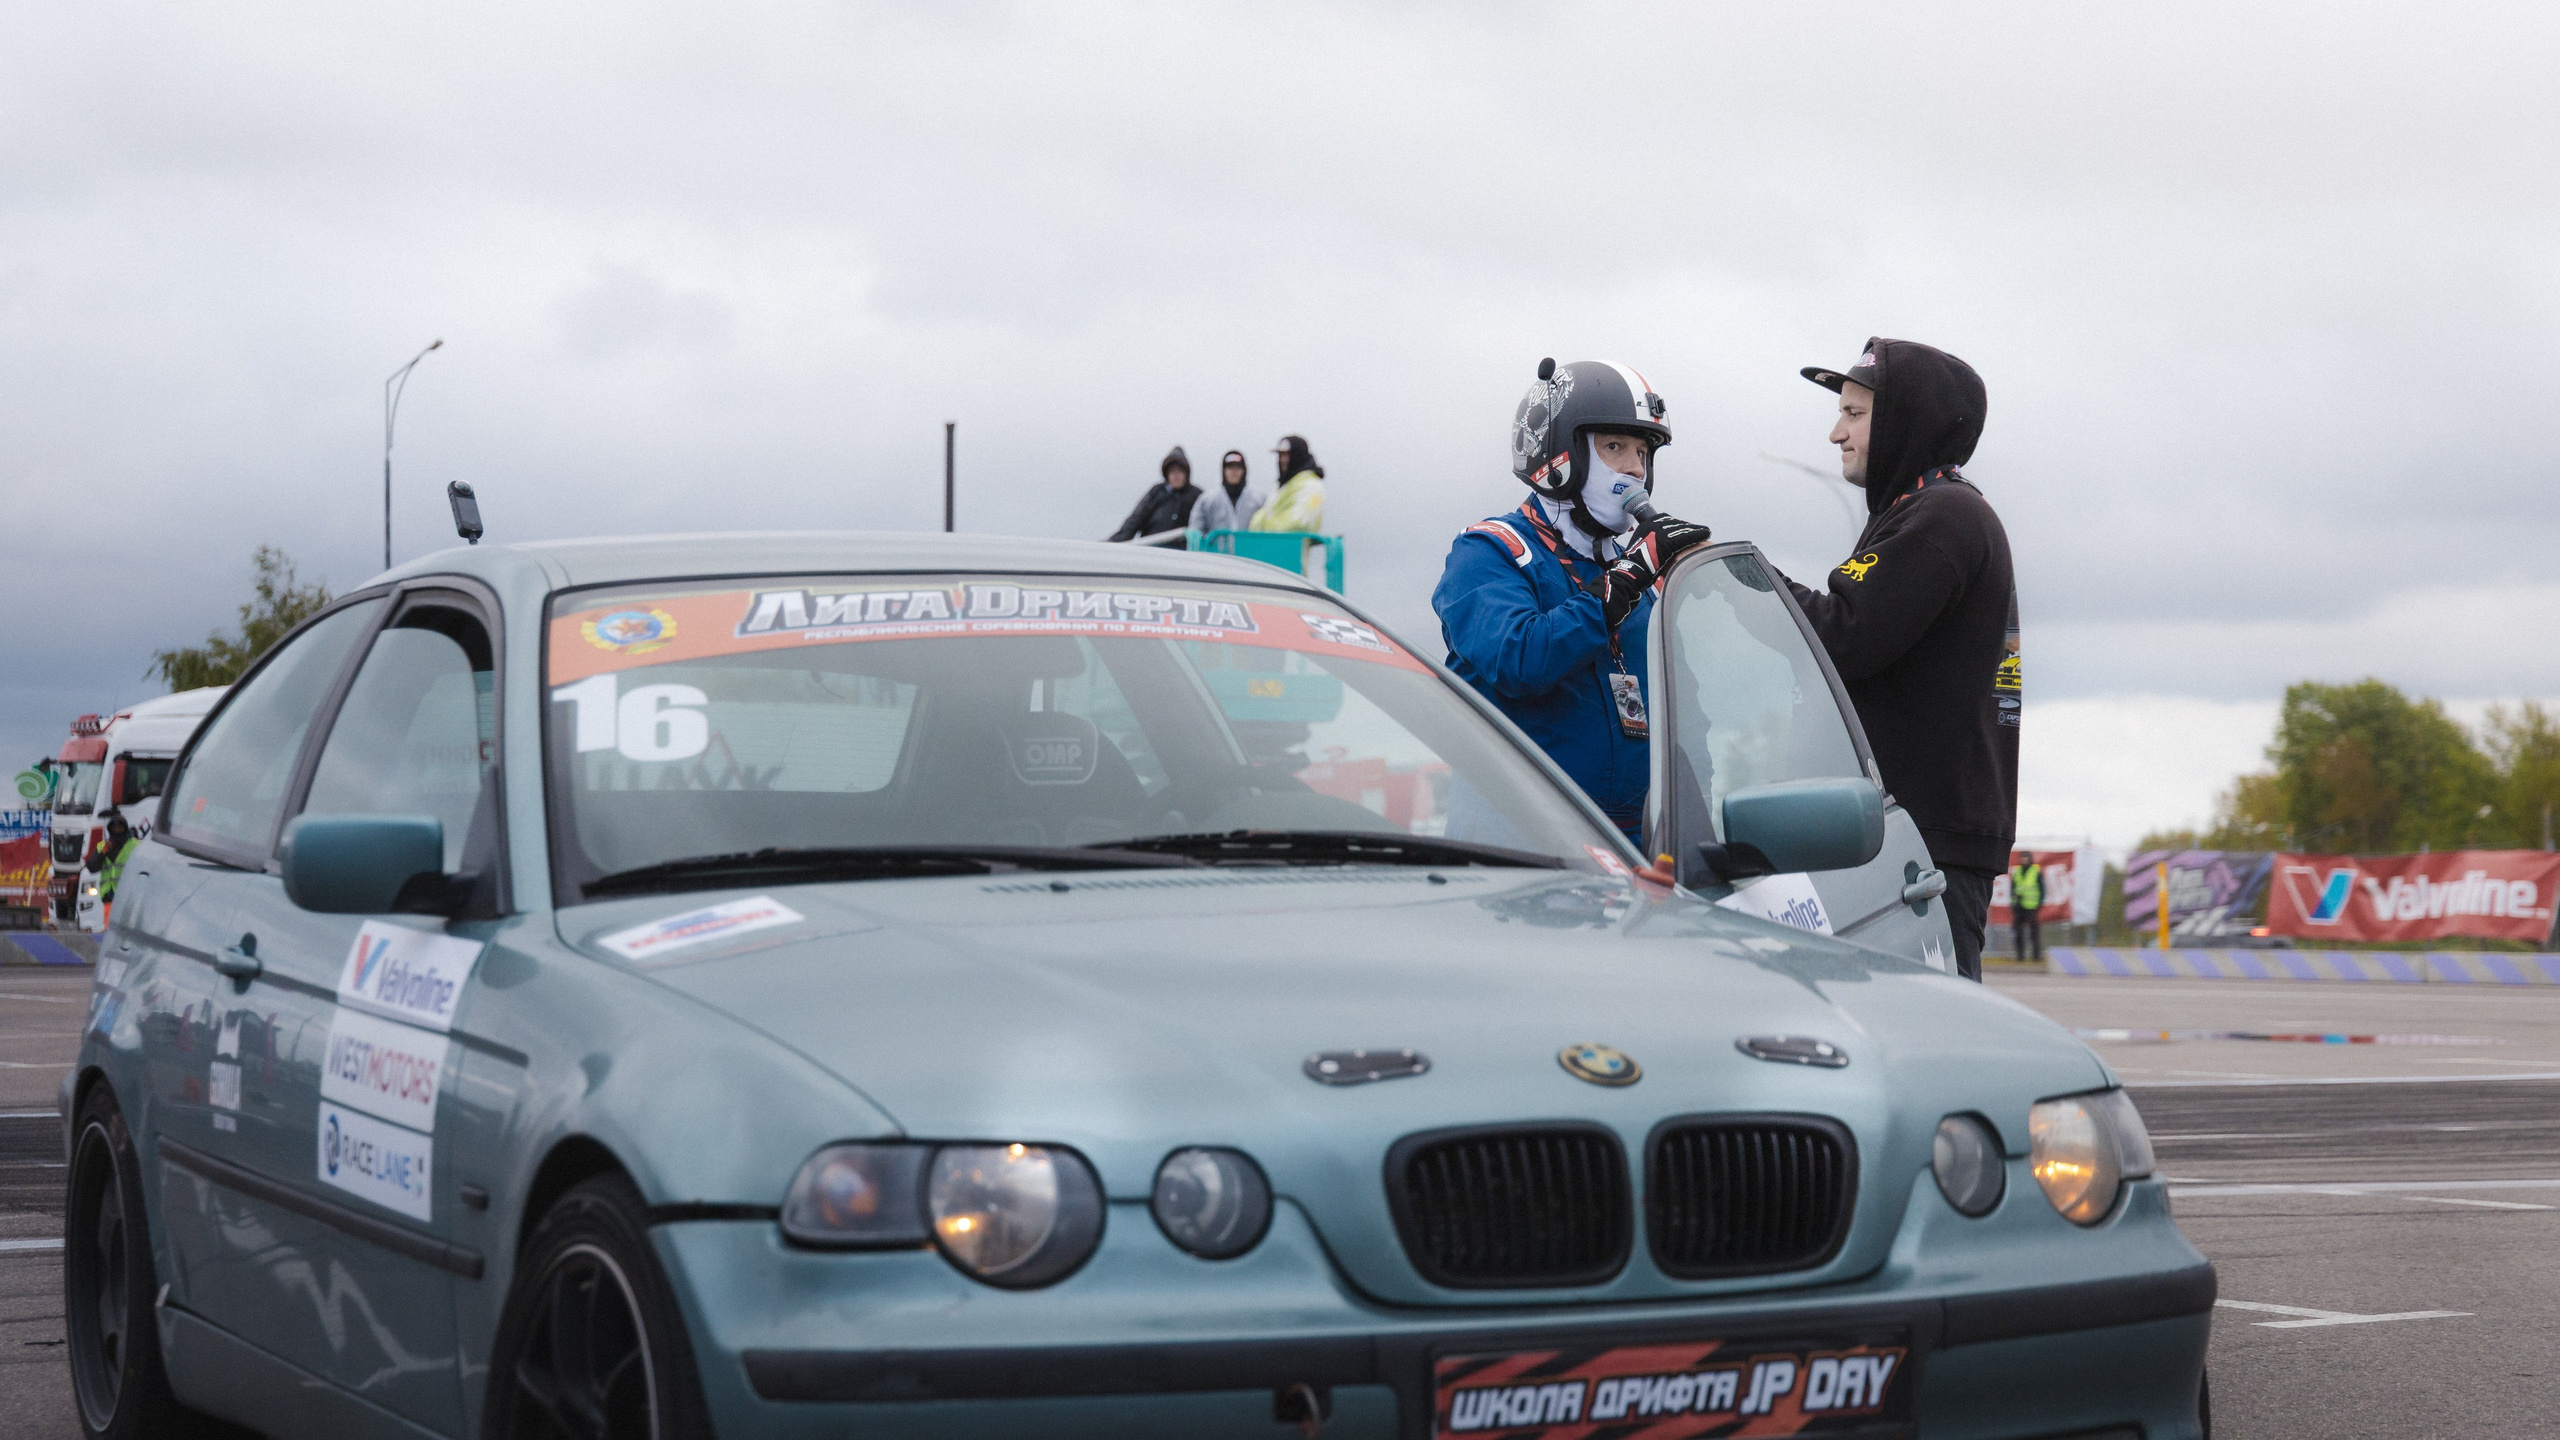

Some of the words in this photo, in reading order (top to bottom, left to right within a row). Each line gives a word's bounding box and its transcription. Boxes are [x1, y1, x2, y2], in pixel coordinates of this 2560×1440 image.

[1104, 624, 1125, 632] ПО
[552, 674, 710, 762] 16
[1026, 743, 1083, 765] OMP
[2362, 869, 2538, 922] Valvoline
[375, 957, 454, 1015] Valvoline
[1450, 1382, 1585, 1431] ШКОЛА
[1590, 1371, 1739, 1421] ДРИФТА
[1741, 1360, 1796, 1415] JP
[1803, 1355, 1896, 1411] DAY
